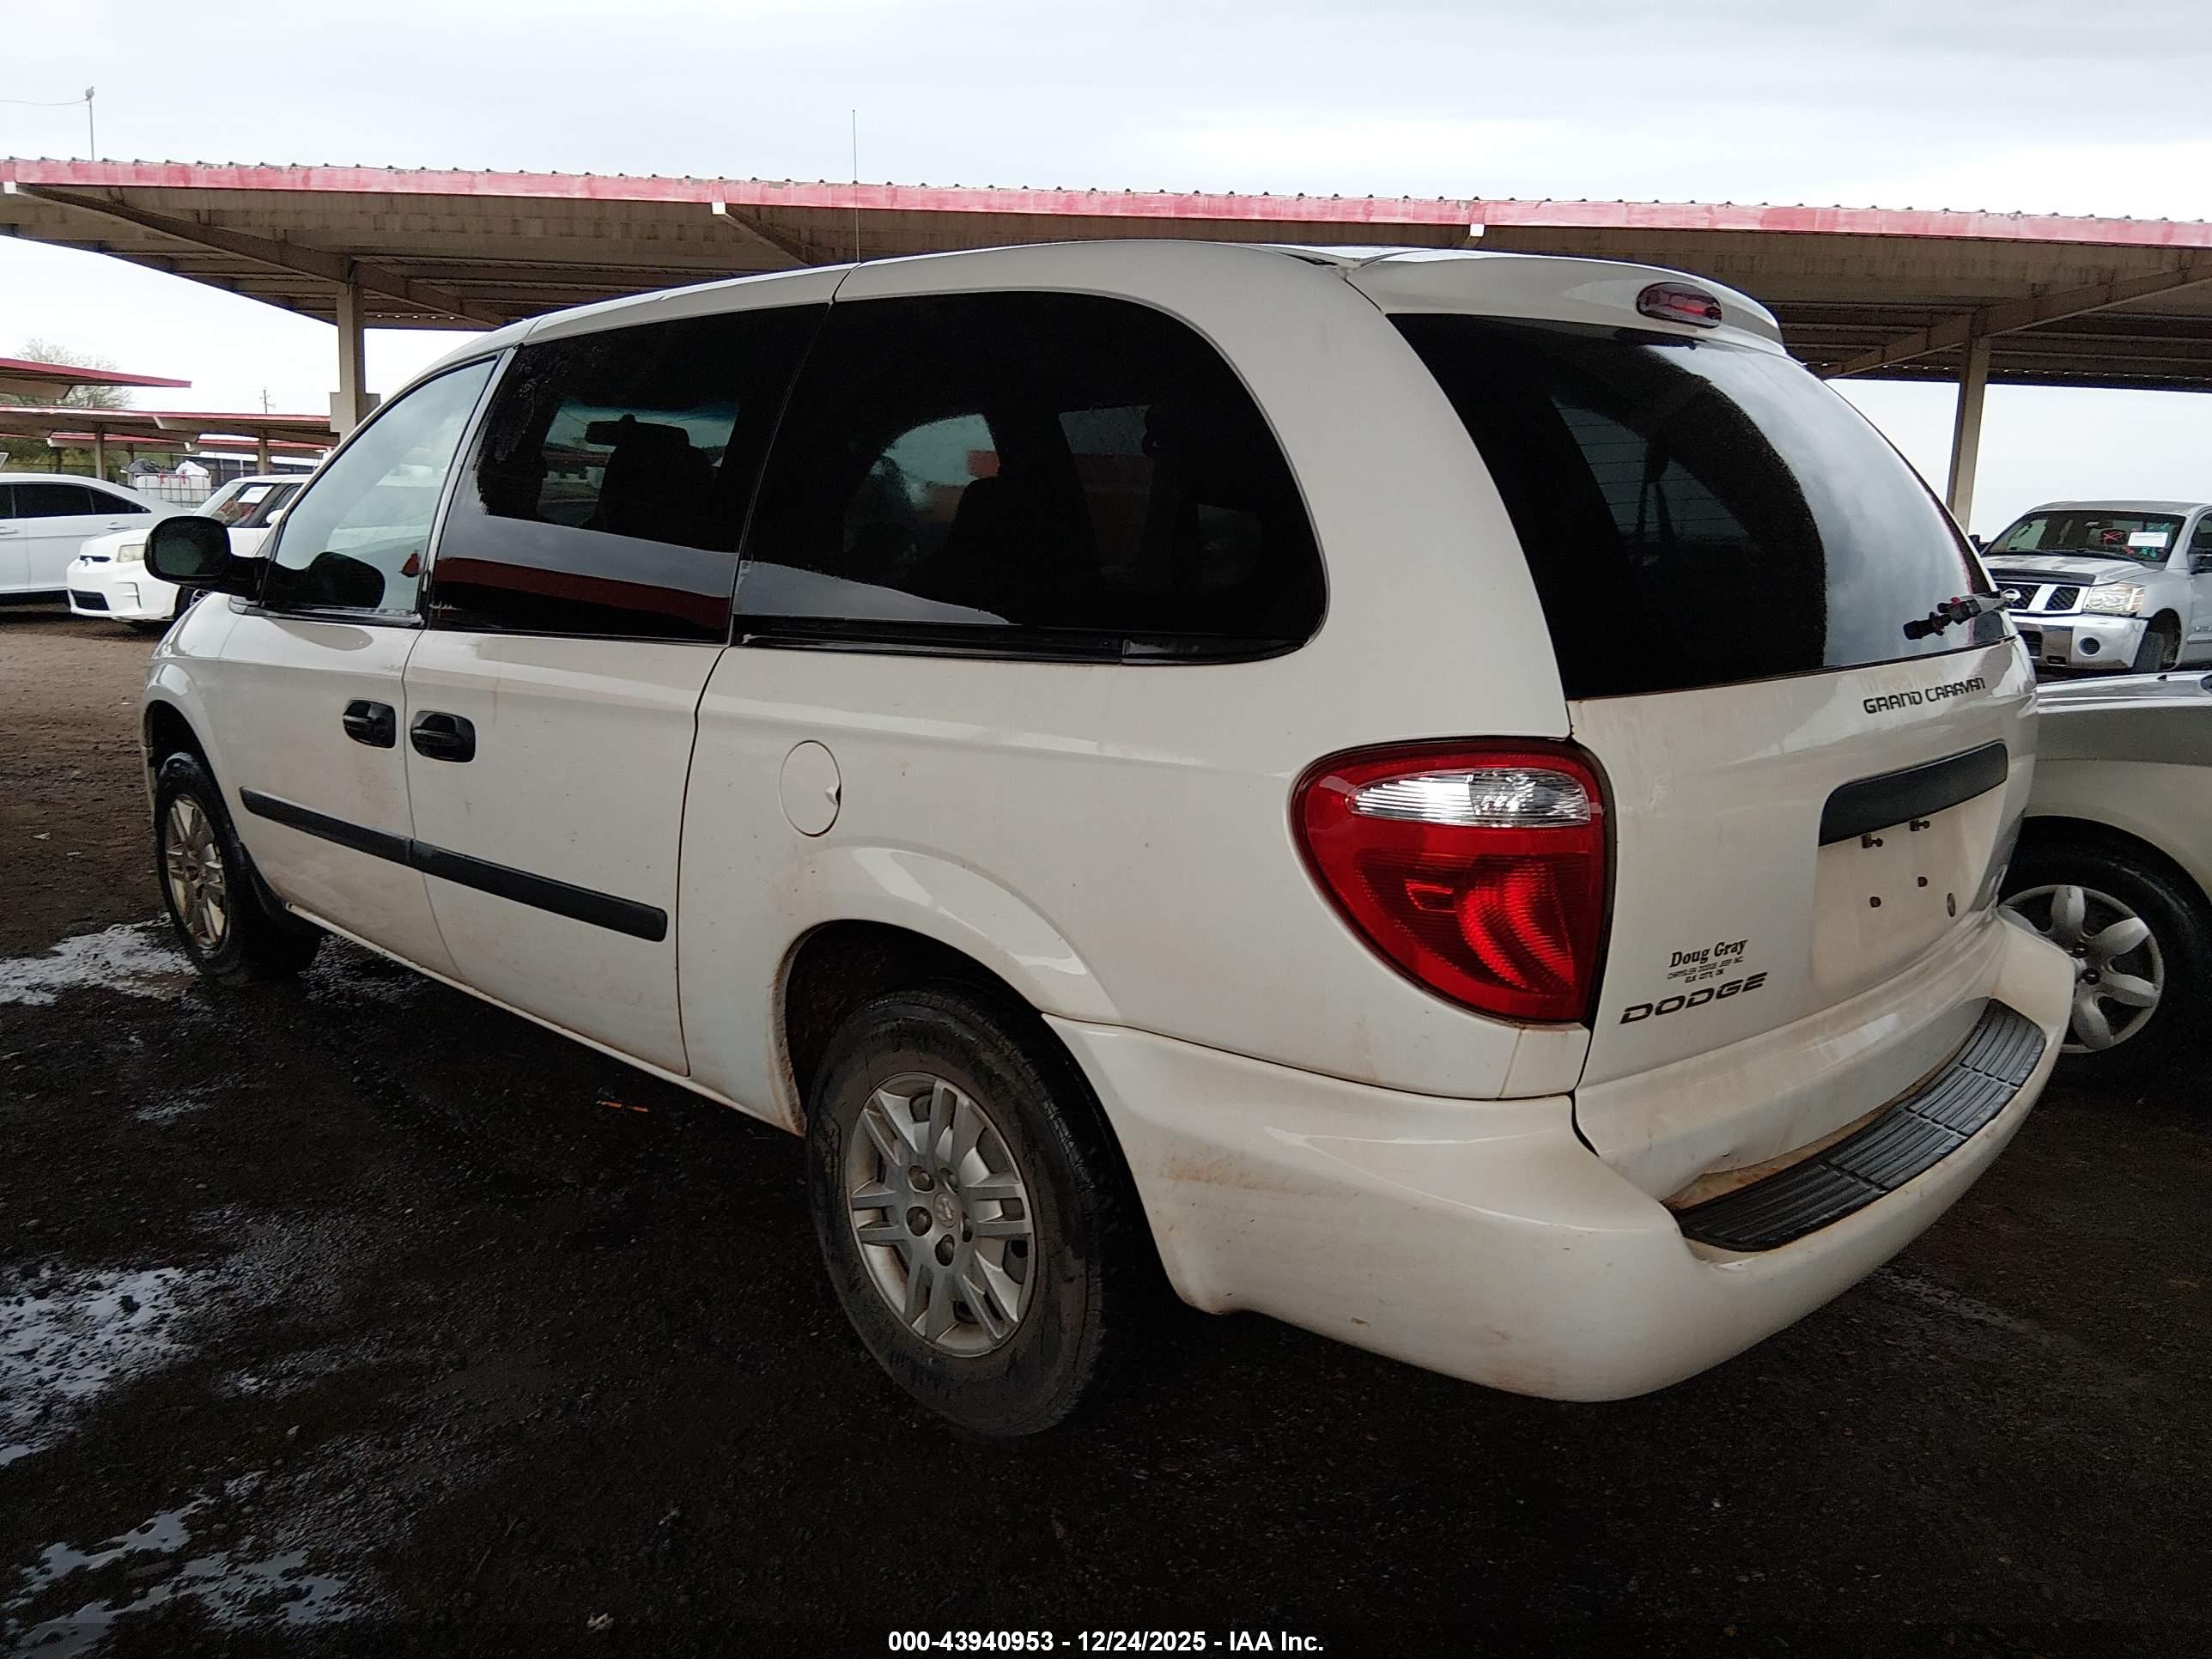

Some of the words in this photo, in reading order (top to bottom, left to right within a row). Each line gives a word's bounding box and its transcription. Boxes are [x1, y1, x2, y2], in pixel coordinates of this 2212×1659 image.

[1863, 690, 1923, 714] GRAND
[1925, 677, 1986, 702] CARAVAN
[1668, 947, 1711, 968] Doug
[1714, 939, 1749, 957] Gray
[1620, 972, 1768, 1024] DODGE
